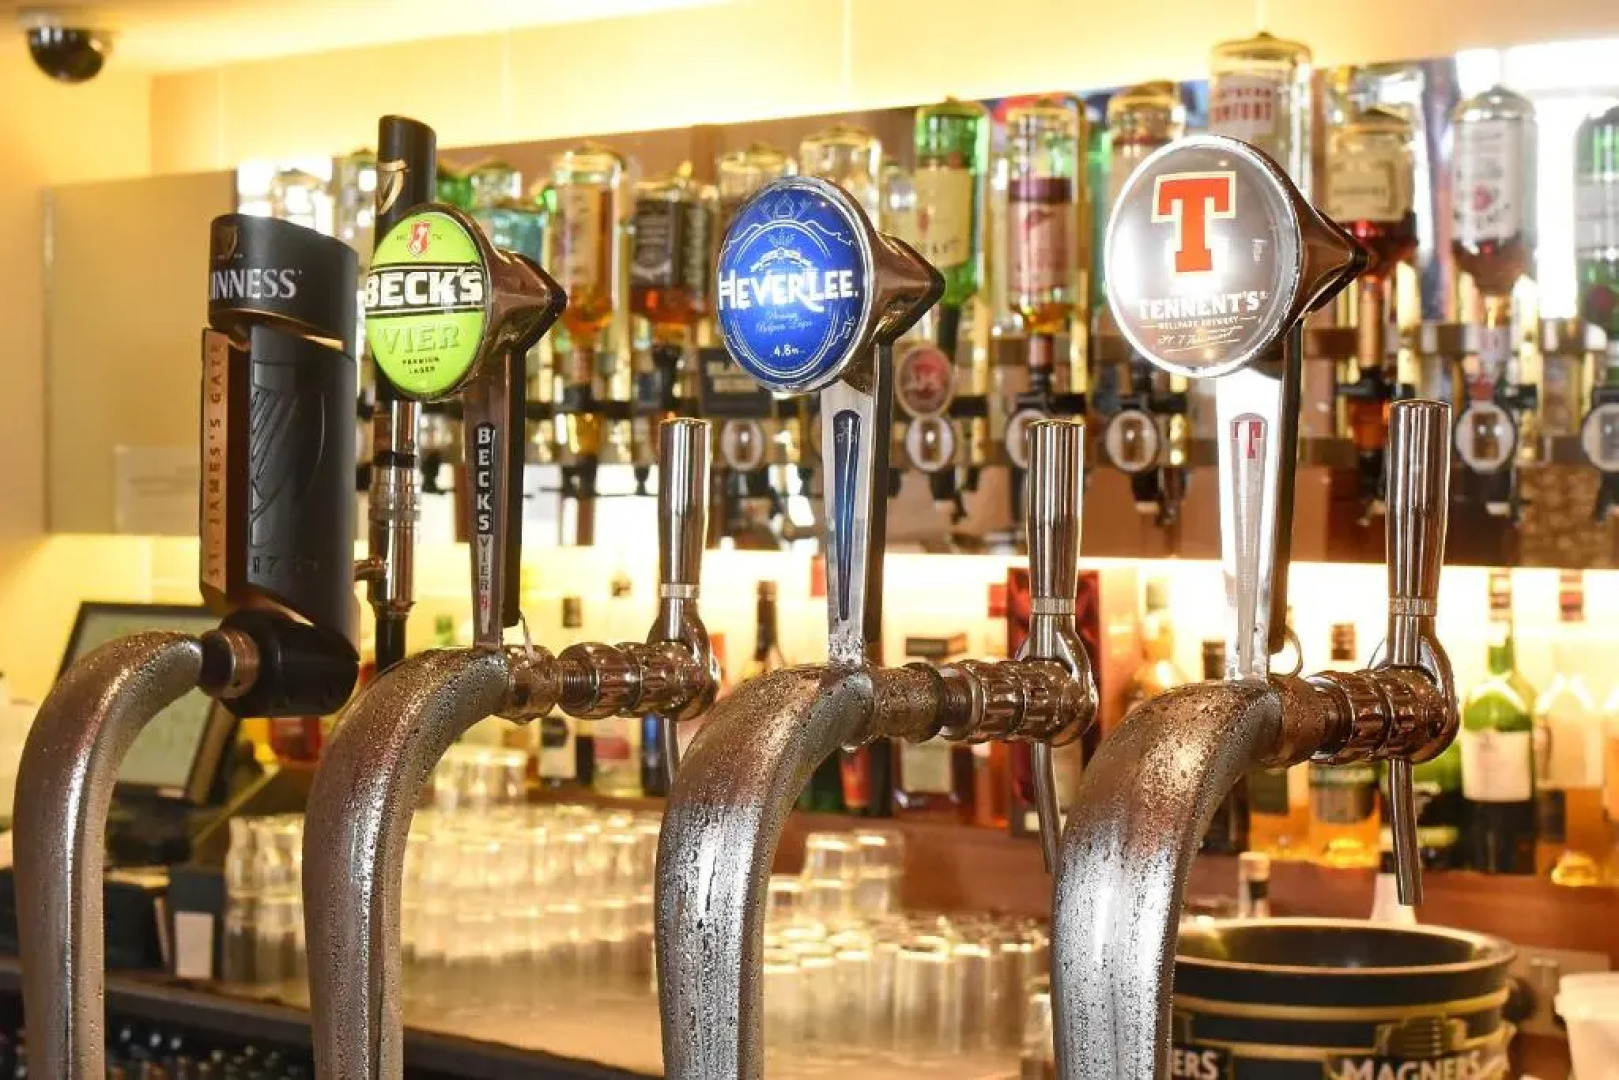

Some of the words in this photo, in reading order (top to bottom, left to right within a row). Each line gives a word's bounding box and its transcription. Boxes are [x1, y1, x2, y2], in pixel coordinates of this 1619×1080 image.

[1151, 171, 1238, 276] T
[365, 267, 483, 309] BECK'S
[1138, 290, 1260, 321] TENNENT'S
[378, 321, 462, 355] VIER
